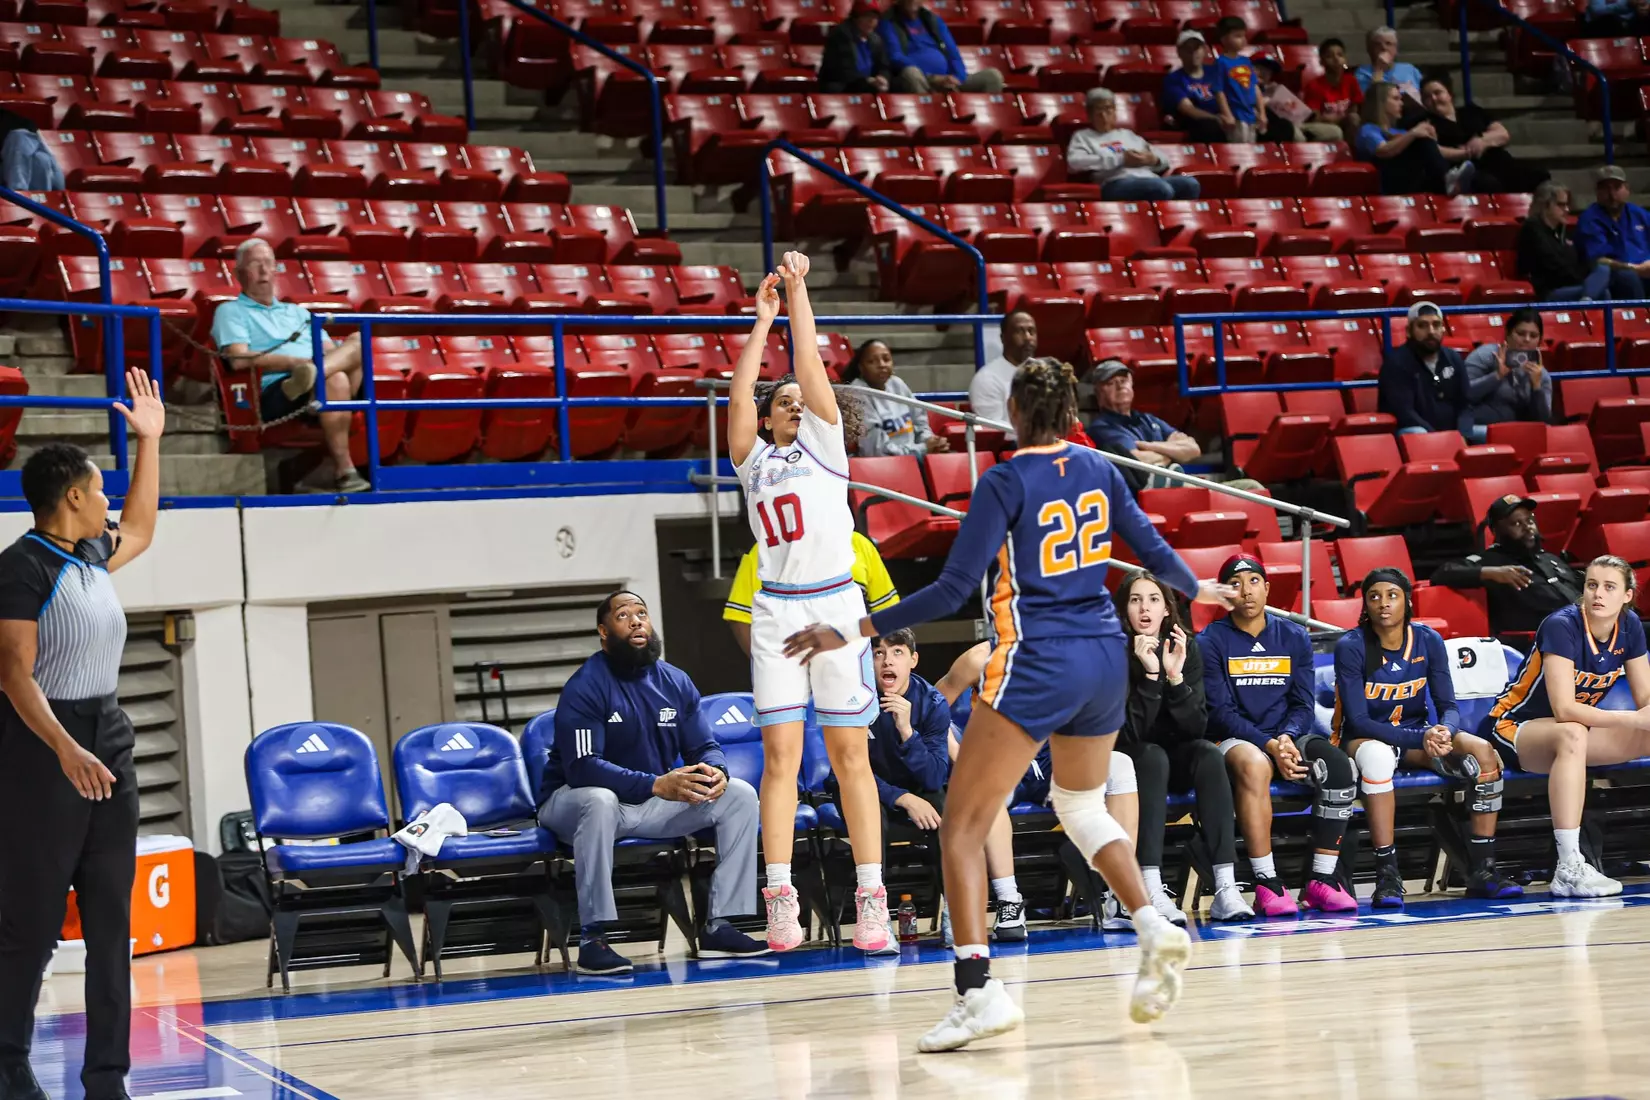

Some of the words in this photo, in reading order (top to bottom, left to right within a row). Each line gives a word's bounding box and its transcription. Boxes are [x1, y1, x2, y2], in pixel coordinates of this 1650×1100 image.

[231, 383, 248, 403] T
[1052, 457, 1070, 477] T
[756, 492, 805, 548] 10
[1037, 488, 1112, 578] 22
[1243, 661, 1280, 671] UTEP
[1236, 678, 1286, 686] MINERS
[1365, 677, 1427, 700] UTEP
[1388, 704, 1404, 727] 4
[148, 863, 171, 909] G
